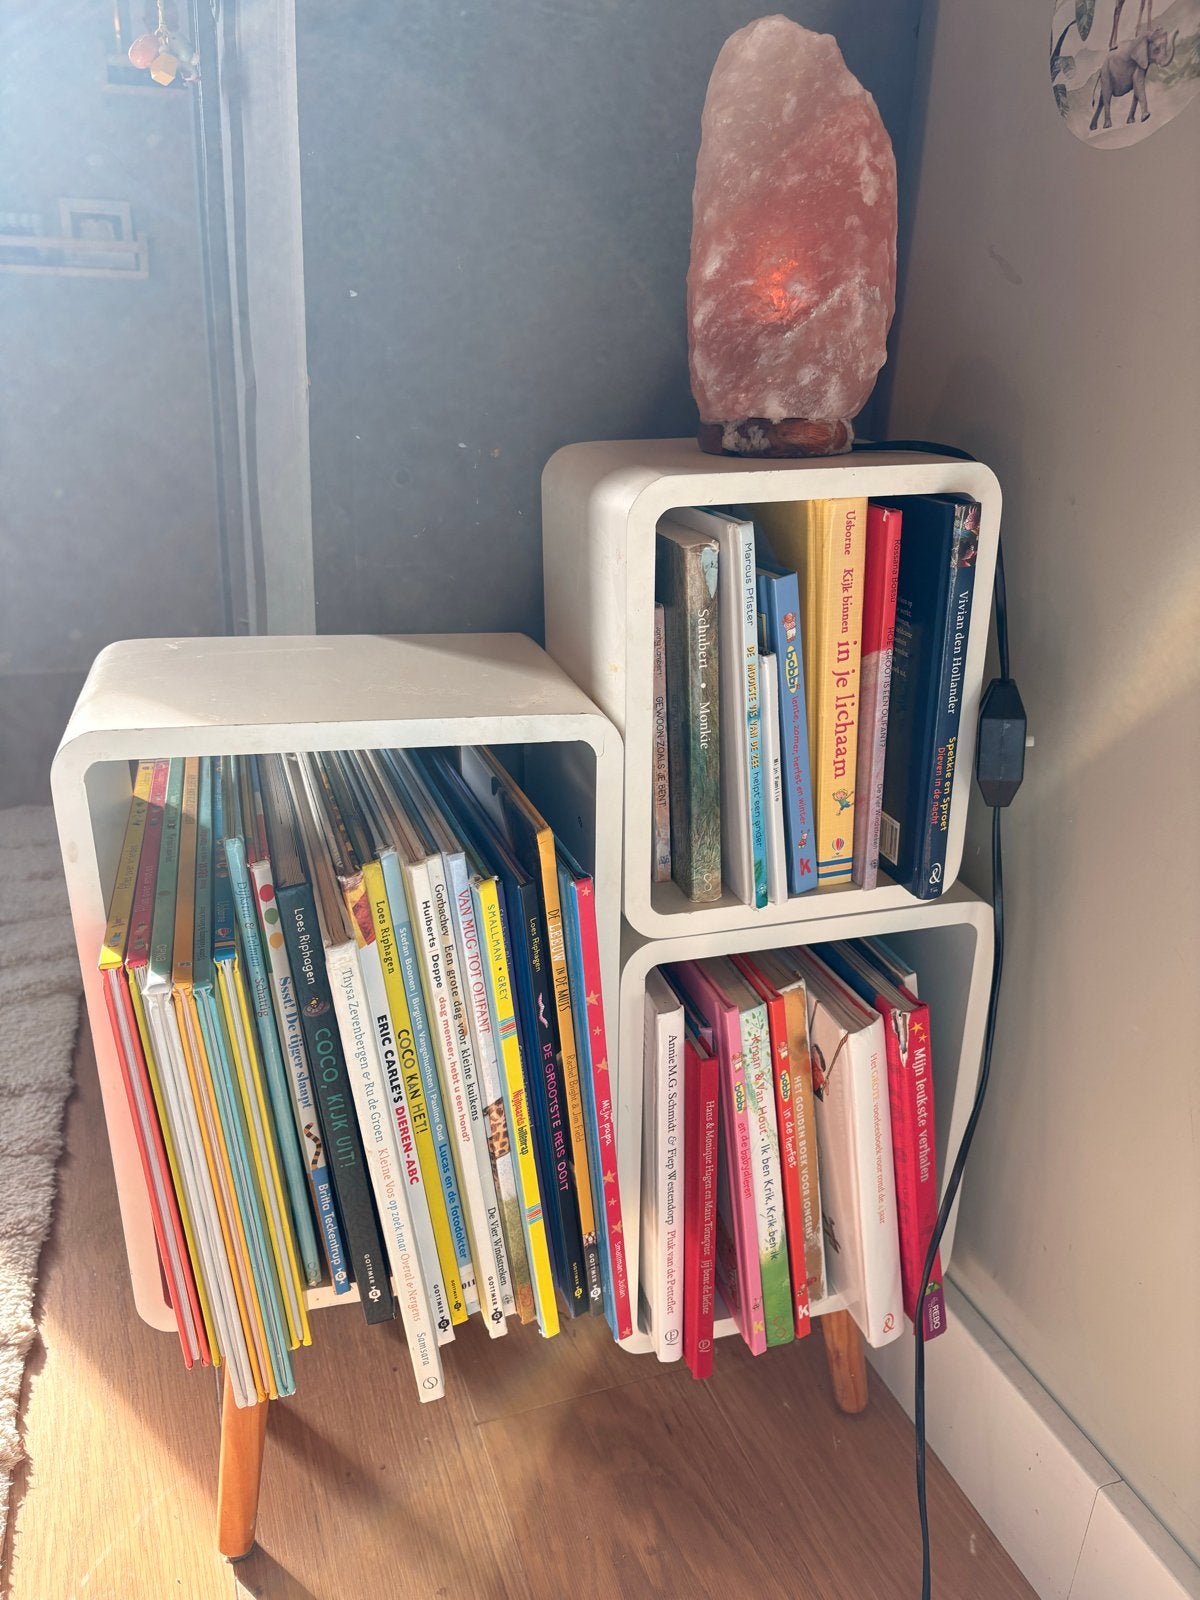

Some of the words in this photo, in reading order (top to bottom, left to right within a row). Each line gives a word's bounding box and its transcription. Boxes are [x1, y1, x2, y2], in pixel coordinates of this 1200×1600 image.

[844, 510, 857, 555] Usborne
[744, 542, 754, 584] Marcus
[841, 568, 854, 594] Kijk
[745, 588, 756, 626] Pfister
[842, 596, 853, 634] binnen
[955, 591, 969, 631] Vivian
[698, 609, 710, 669] Schubert
[838, 640, 857, 663] in
[953, 632, 966, 655] den
[785, 650, 799, 690] bobbi
[832, 665, 856, 688] je
[884, 648, 894, 682] GROOT
[948, 657, 964, 714] Hollander
[699, 702, 711, 750] Monkie
[833, 694, 855, 779] lichaam
[934, 747, 946, 776] Dieven
[944, 736, 957, 779] Spekkie
[933, 788, 943, 800] de
[934, 778, 943, 787] in
[943, 781, 952, 795] en
[931, 801, 942, 825] nacht
[939, 797, 952, 832] Sproet
[376, 900, 387, 925] Loes
[435, 884, 450, 936] Gorbachev
[458, 889, 471, 917] VAN
[548, 908, 561, 920] DE
[294, 907, 307, 932] Loes
[529, 918, 540, 936] Loes
[399, 927, 410, 956] Stefan
[422, 900, 436, 948] Huiberts
[431, 954, 444, 988] Deppe
[463, 919, 478, 949] MUG
[549, 922, 566, 962] LEEUW
[299, 934, 316, 984] Riphagen
[380, 927, 397, 975] Riphagen
[444, 945, 454, 965] Een
[469, 951, 482, 978] TOT
[487, 904, 502, 961] SMALLMAN
[497, 976, 508, 1000] GREY
[531, 937, 544, 972] Riphagen
[341, 968, 355, 1000] Thysa
[405, 958, 417, 991] Boonen
[446, 970, 459, 996] grote
[555, 966, 565, 975] IN
[555, 976, 568, 988] DE
[279, 976, 294, 1009] Ssst!
[557, 989, 571, 1012] MUIS
[286, 1010, 299, 1030] De
[411, 997, 424, 1029] Birgitte
[437, 997, 448, 1017] dag
[453, 1001, 465, 1020] dag
[473, 981, 490, 1033] OLIFANT
[348, 1002, 370, 1070] Zevenbergen
[377, 1014, 392, 1046] ERIC
[442, 1020, 456, 1060] meneer,
[457, 1022, 467, 1045] voor
[287, 1034, 305, 1069] tijger
[315, 1028, 339, 1089] COCO,
[397, 1029, 416, 1068] COCO
[417, 1031, 435, 1088] Vangehuchten
[543, 1043, 553, 1059] DE
[667, 1035, 678, 1063] Annie
[751, 1034, 762, 1069] Kraan
[912, 1047, 927, 1076] Mijn
[384, 1050, 404, 1103] CARLE'S
[448, 1062, 460, 1083] hebt
[460, 1048, 473, 1079] kleine
[295, 1072, 313, 1109] slaapt
[365, 1082, 376, 1097] Ru
[406, 1074, 422, 1100] KAN
[667, 1065, 678, 1091] M.G.
[780, 1072, 791, 1099] bobbi
[794, 1076, 803, 1094] HET
[369, 1099, 379, 1110] de
[429, 1094, 441, 1122] Pauline
[455, 1095, 464, 1112] een
[466, 1082, 480, 1121] kuikens
[545, 1063, 562, 1128] GROOTSTE
[734, 1083, 745, 1112] bobbi
[756, 1086, 767, 1104] Van
[914, 1078, 927, 1127] leukste
[327, 1094, 349, 1131] KIJK
[412, 1104, 428, 1134] HET!
[600, 1100, 612, 1121] Mijn
[667, 1093, 678, 1132] Schmidt
[758, 1106, 768, 1135] Hout
[783, 1107, 793, 1119] in
[795, 1097, 806, 1138] GOUDEN
[371, 1112, 385, 1143] Groen
[436, 1124, 444, 1141] Oud
[458, 1114, 470, 1142] hond?
[599, 1123, 612, 1145] papa
[667, 1136, 676, 1145] &
[738, 1123, 746, 1133] en
[740, 1135, 748, 1148] de
[785, 1121, 795, 1134] de
[336, 1135, 357, 1168] UIT!
[395, 1106, 419, 1185] DIEREN-ABC
[438, 1143, 452, 1174] Lucas
[552, 1131, 566, 1158] REIS
[761, 1144, 771, 1155] Ik
[786, 1137, 799, 1168] herfst
[799, 1141, 809, 1167] BOEK
[917, 1130, 931, 1182] verhalen
[378, 1148, 392, 1180] Kleine
[665, 1149, 677, 1170] Fiep
[762, 1158, 773, 1176] ben
[445, 1176, 454, 1189] en
[557, 1162, 569, 1191] OOIT
[741, 1149, 753, 1199] babydieren
[801, 1169, 810, 1195] VOOR
[318, 1183, 332, 1210] Britta
[384, 1182, 397, 1198] Vos
[448, 1191, 458, 1204] de
[665, 1171, 677, 1225] Westendorp
[765, 1180, 774, 1205] Krik,
[386, 1200, 398, 1211] op
[488, 1207, 498, 1220] De
[766, 1207, 777, 1228] Krik
[803, 1198, 813, 1239] JONGENS
[391, 1212, 405, 1232] zoek
[450, 1206, 468, 1258] fotodokter
[490, 1221, 503, 1237] Vier
[324, 1211, 341, 1265] Teckentrup
[396, 1233, 408, 1252] naar
[666, 1230, 677, 1250] Pluk
[768, 1230, 778, 1248] ben
[364, 1253, 376, 1284] GOTTMER
[400, 1253, 415, 1281] Overal
[492, 1238, 508, 1286] Windstreken
[666, 1251, 675, 1266] van
[769, 1250, 779, 1260] ik
[666, 1268, 676, 1278] de
[432, 1283, 445, 1314] GOTTMER
[488, 1275, 498, 1305] GOTTMER
[406, 1290, 421, 1322] Nergens
[932, 1304, 941, 1329] REBO
[416, 1332, 431, 1366] Samsara
